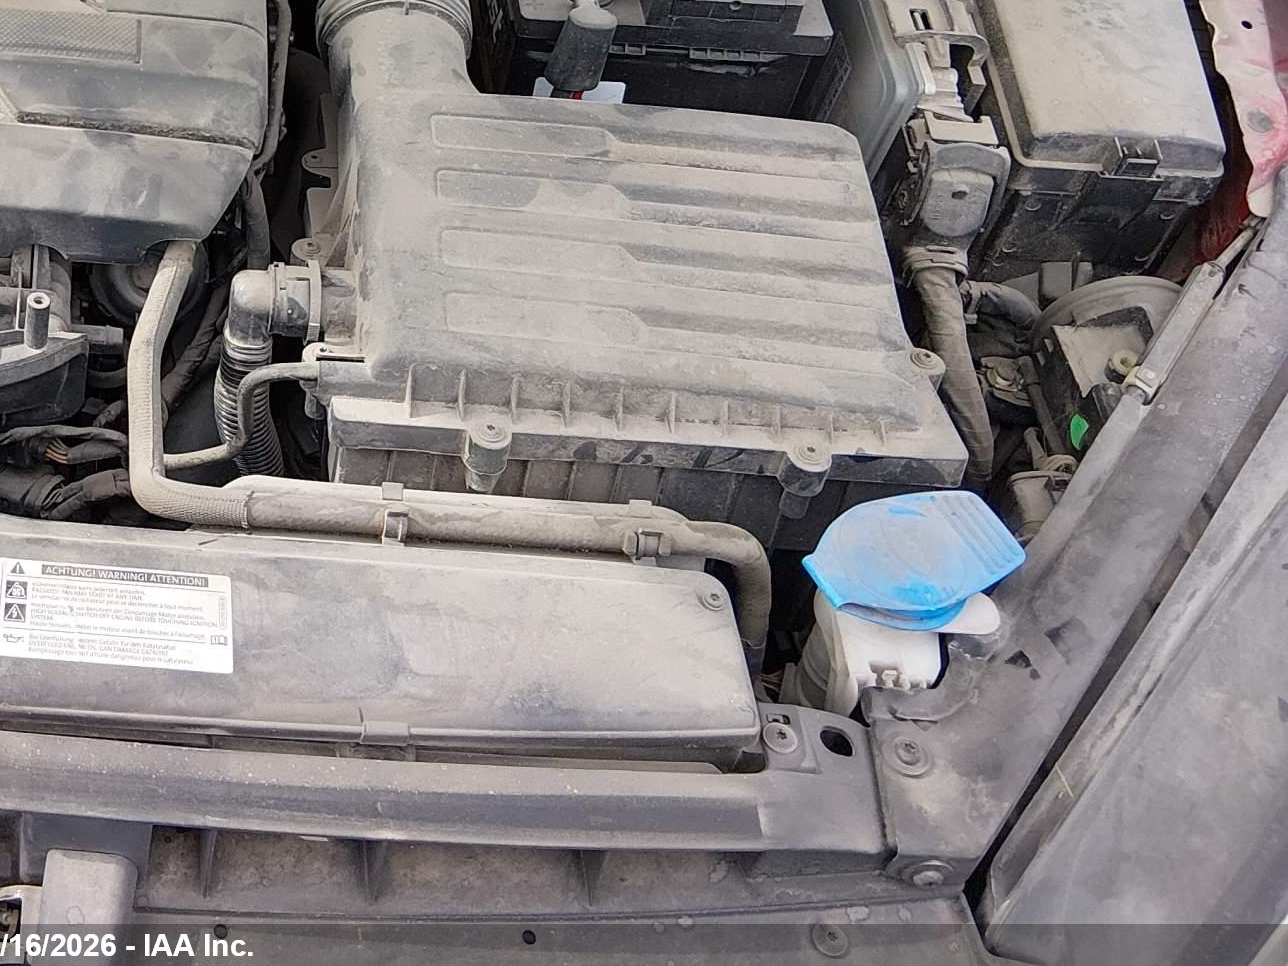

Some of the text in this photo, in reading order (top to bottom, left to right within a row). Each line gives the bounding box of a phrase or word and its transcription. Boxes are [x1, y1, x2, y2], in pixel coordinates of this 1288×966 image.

[45, 566, 204, 585] ACHTUNG! WARNING! ATTENTION!
